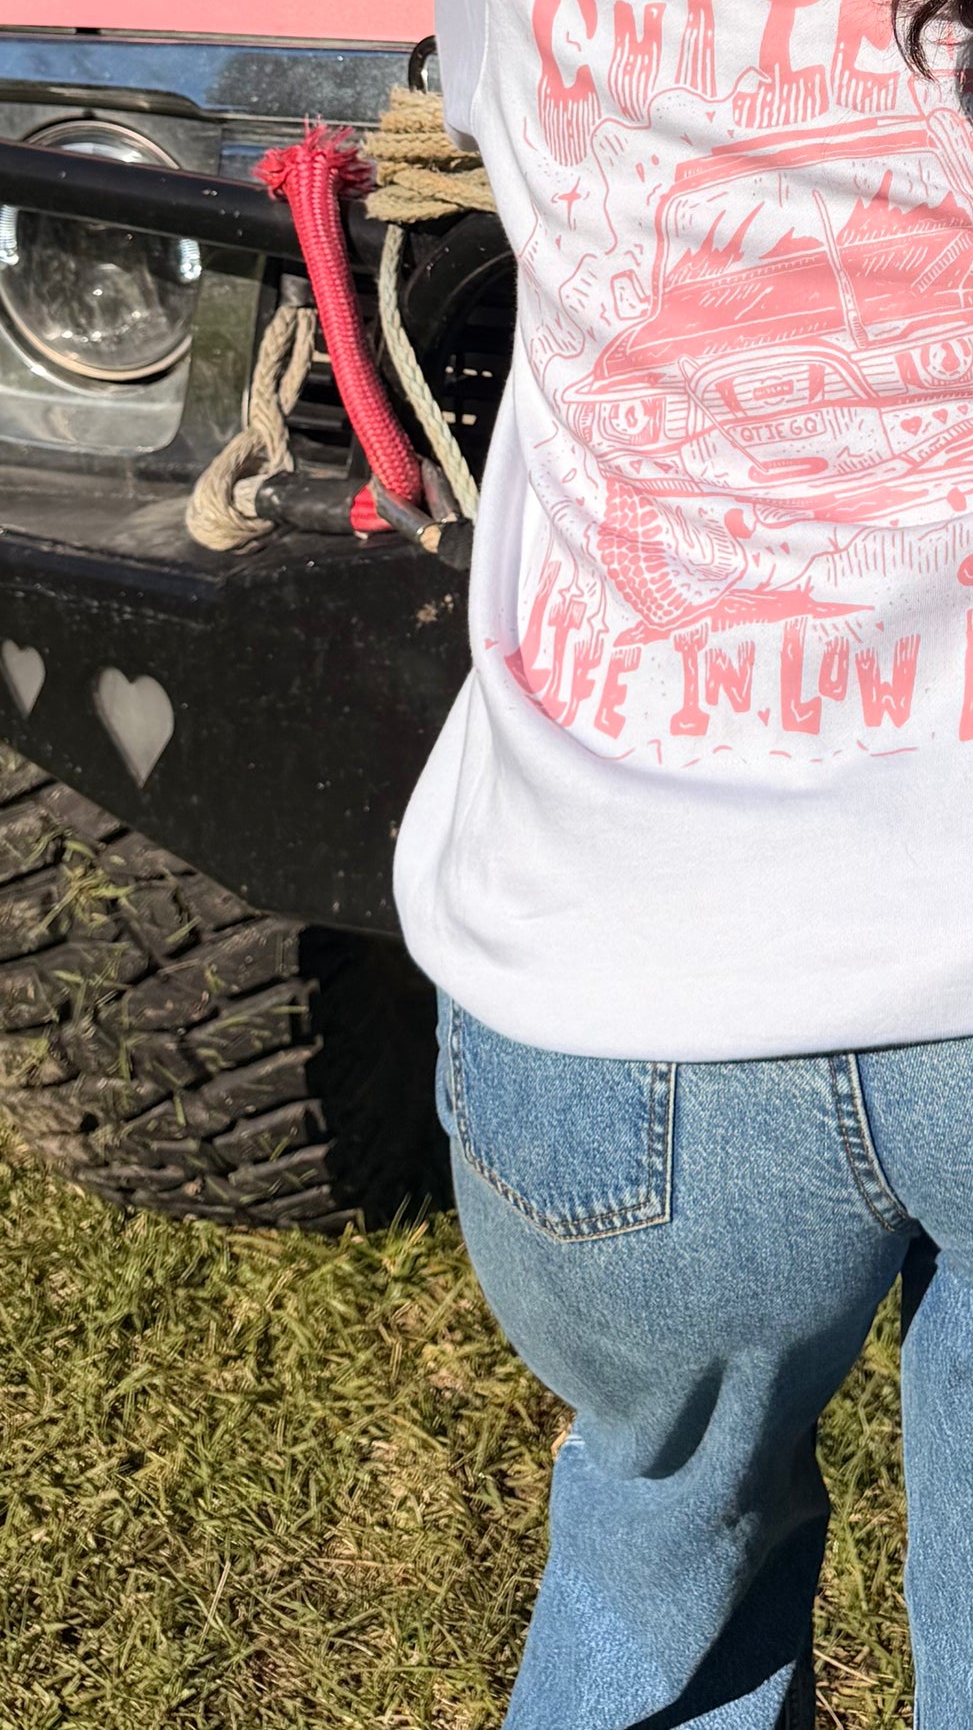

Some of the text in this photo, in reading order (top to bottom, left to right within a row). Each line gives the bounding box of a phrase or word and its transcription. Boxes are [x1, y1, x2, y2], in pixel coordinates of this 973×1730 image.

[503, 560, 642, 740] LIFE
[669, 621, 755, 736] IN
[780, 615, 921, 734] LOW
